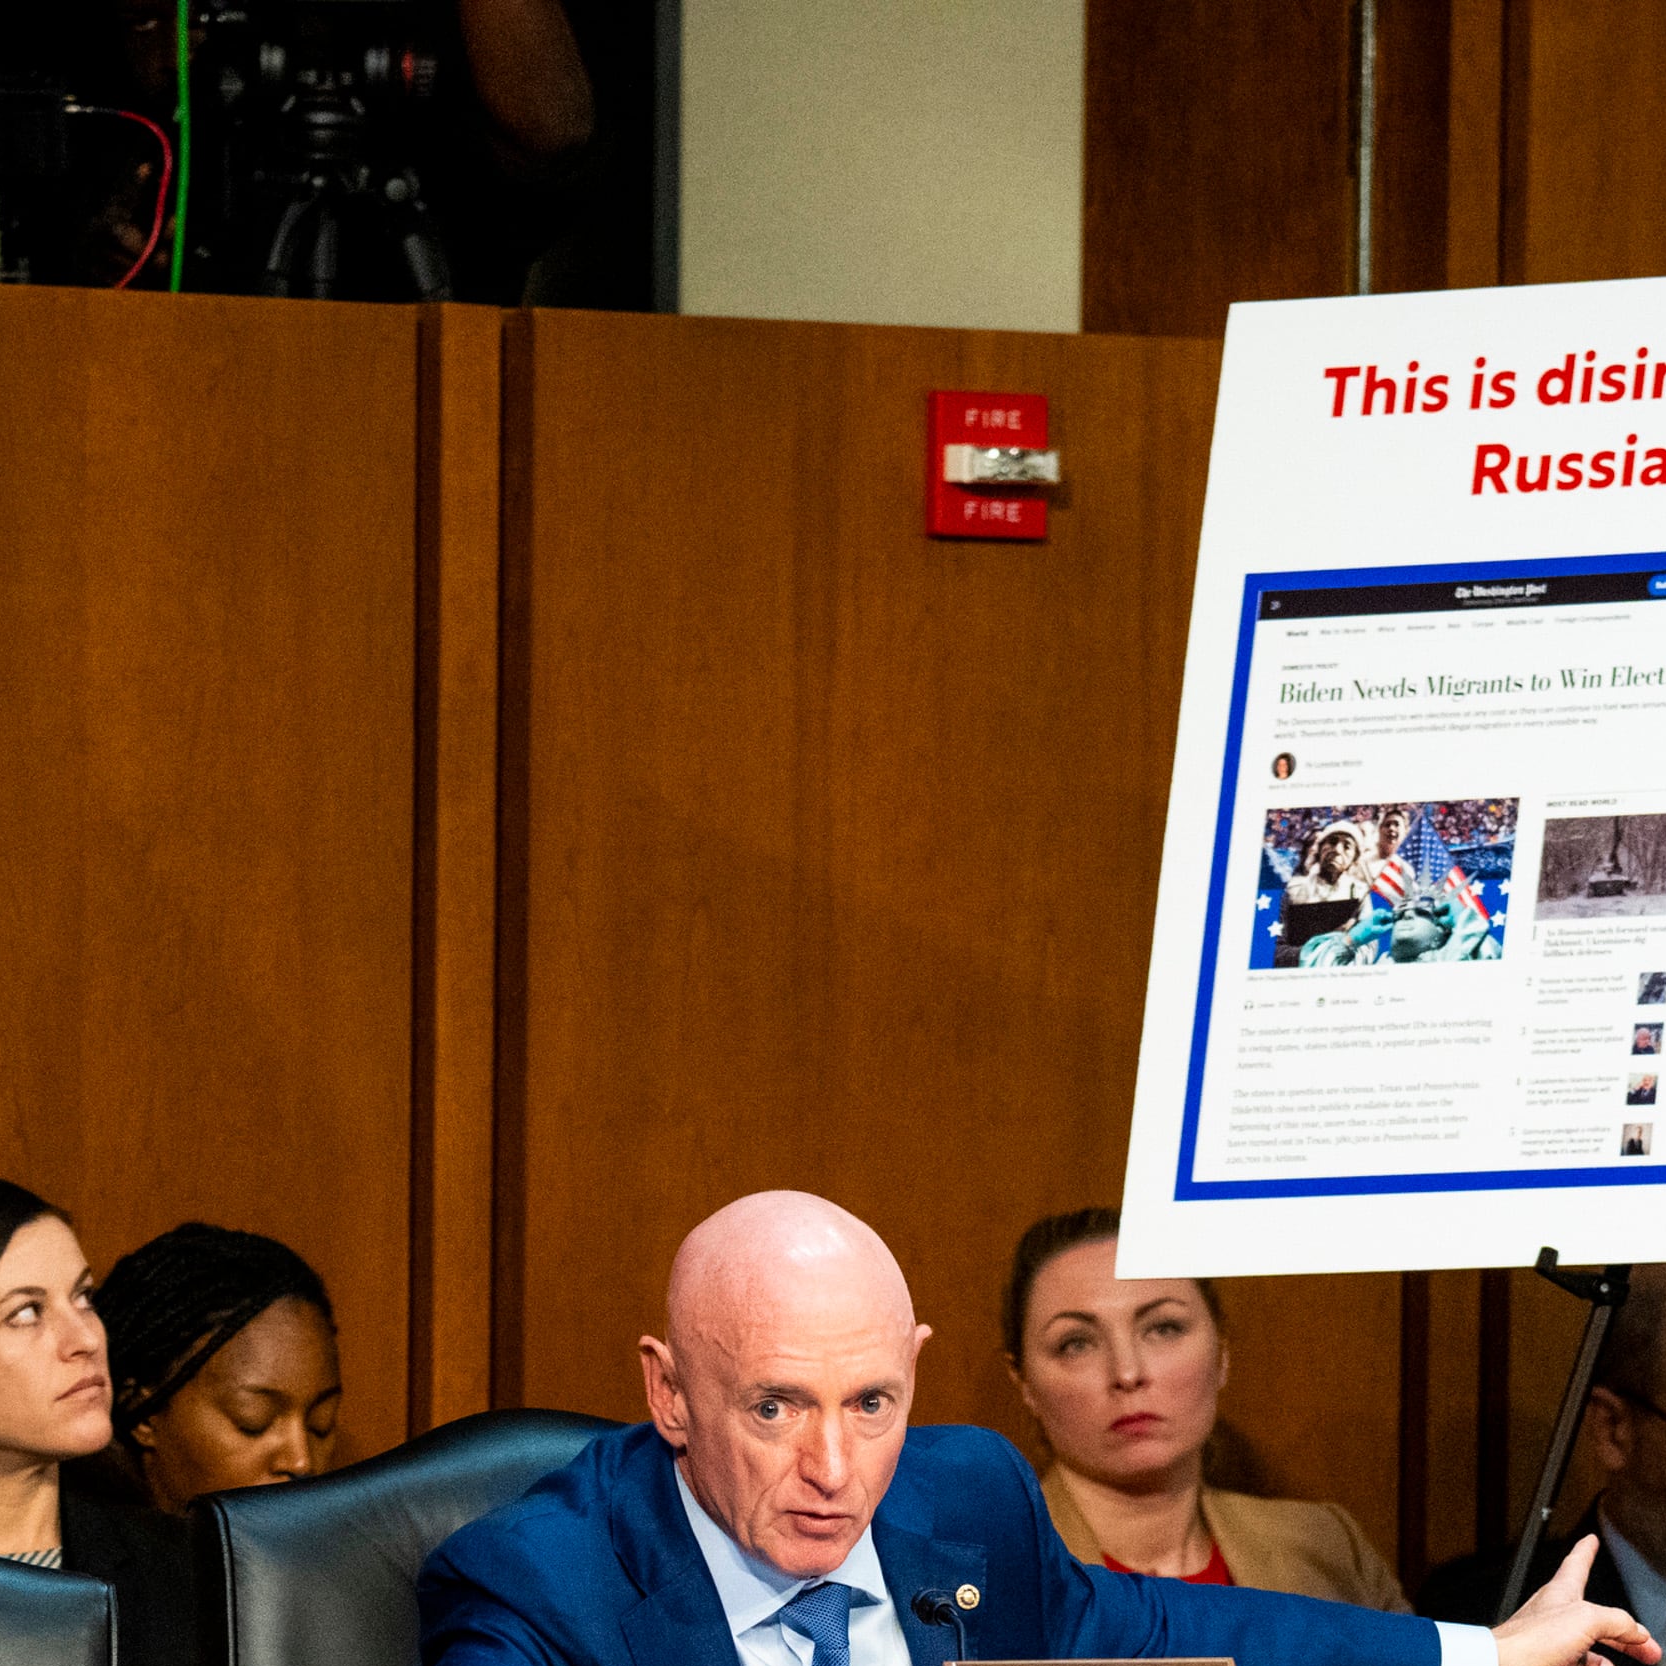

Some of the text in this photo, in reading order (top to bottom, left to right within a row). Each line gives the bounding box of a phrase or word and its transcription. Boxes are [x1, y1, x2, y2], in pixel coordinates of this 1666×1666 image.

[1324, 360, 1449, 418] This
[1470, 356, 1516, 410] is
[964, 408, 1022, 430] FIRE
[963, 501, 1022, 523] FIRE
[1279, 681, 1342, 703] Biden
[1353, 676, 1416, 699] Needs
[1426, 675, 1523, 702] Migrants
[1530, 673, 1551, 691] to
[1560, 668, 1601, 688] Win
[1568, 799, 1588, 807] READ
[1590, 798, 1617, 806] WORLD
